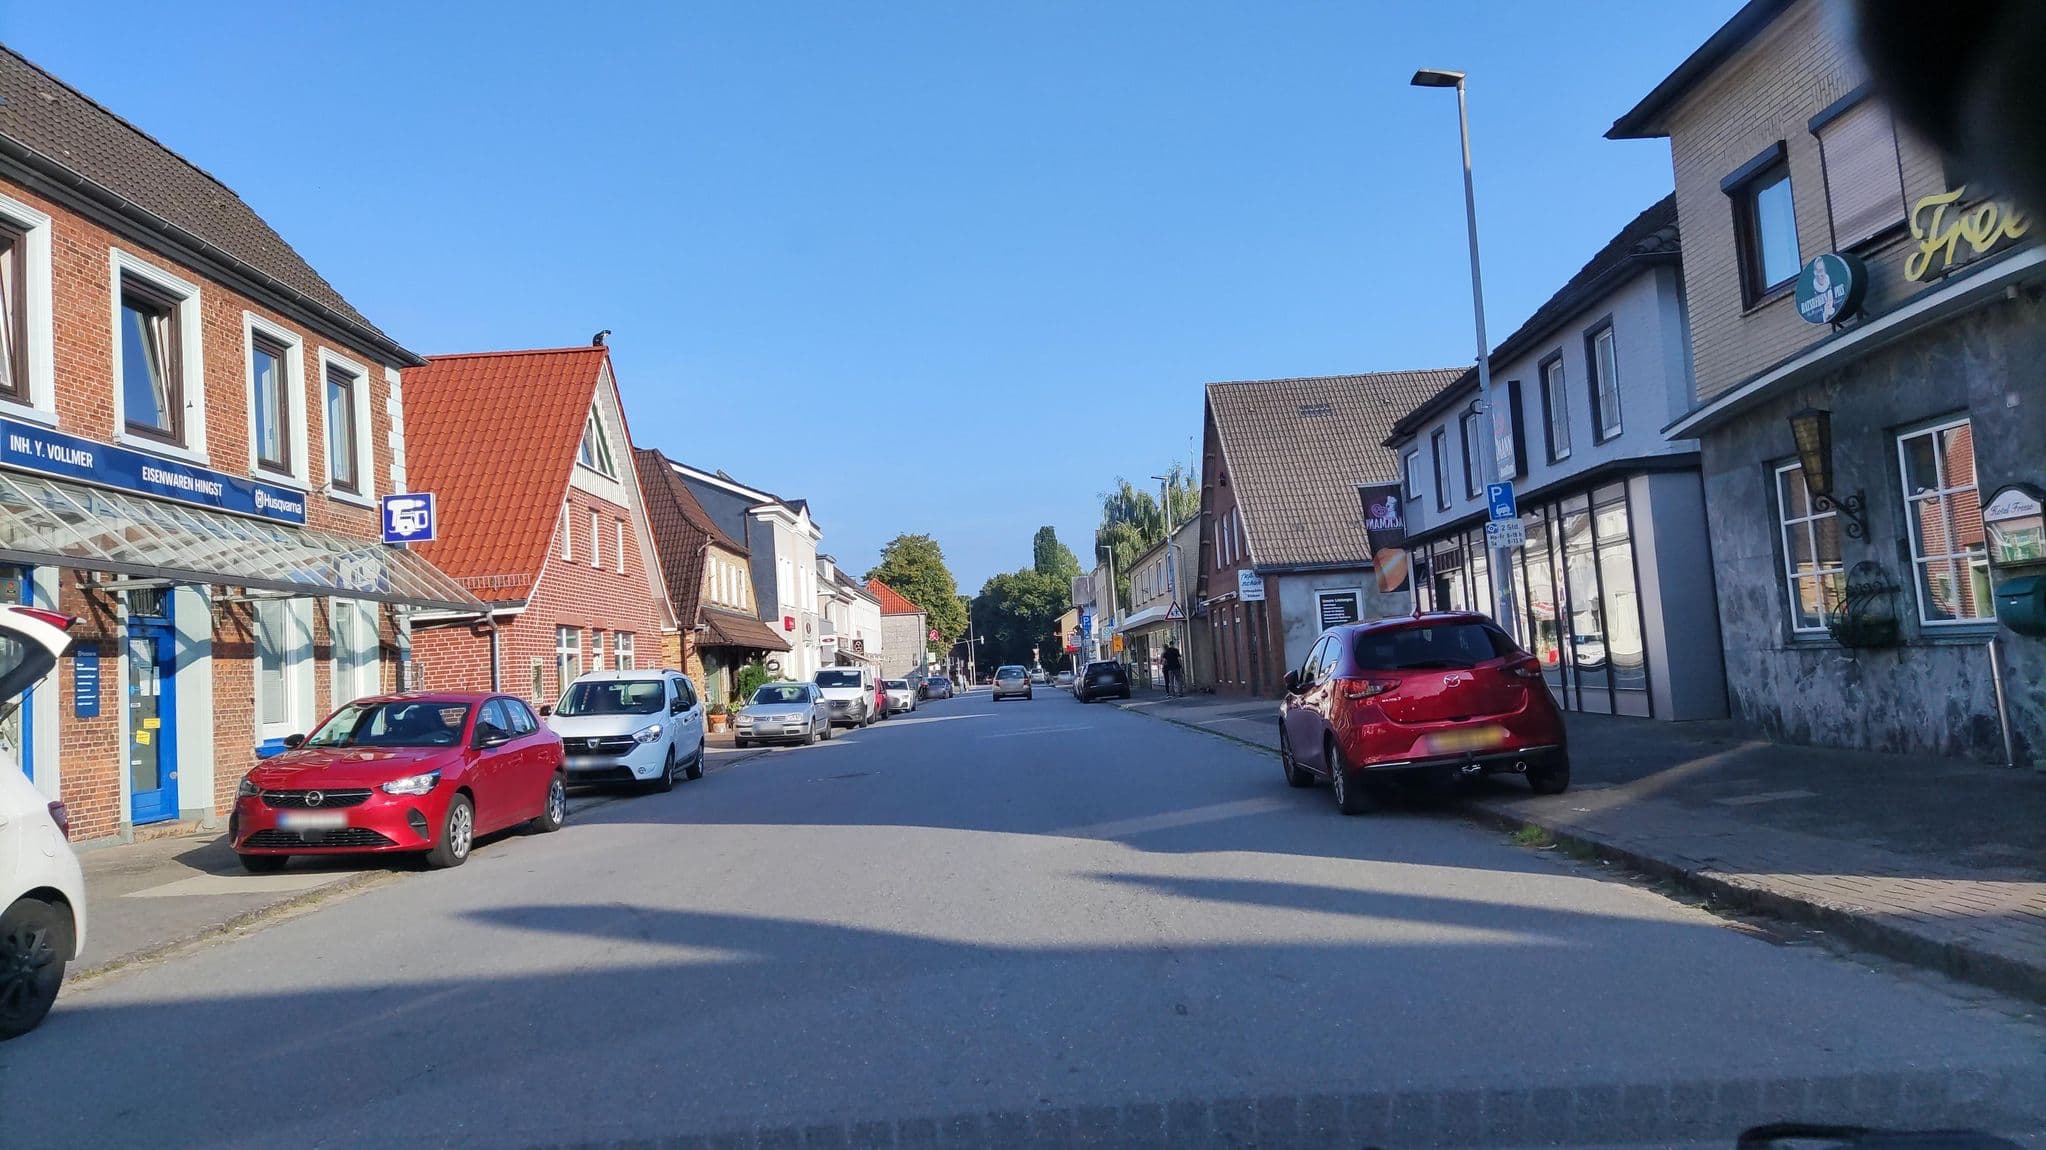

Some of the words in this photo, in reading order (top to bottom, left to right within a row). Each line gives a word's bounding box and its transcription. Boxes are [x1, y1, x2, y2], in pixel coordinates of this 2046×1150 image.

[10, 434, 33, 455] INH.
[35, 440, 45, 458] Y.
[46, 443, 93, 468] VOLLMER
[142, 466, 194, 492] EISENWAREN
[194, 478, 223, 497] HINGST
[1491, 486, 1503, 503] P
[264, 493, 302, 514] Husqvarna
